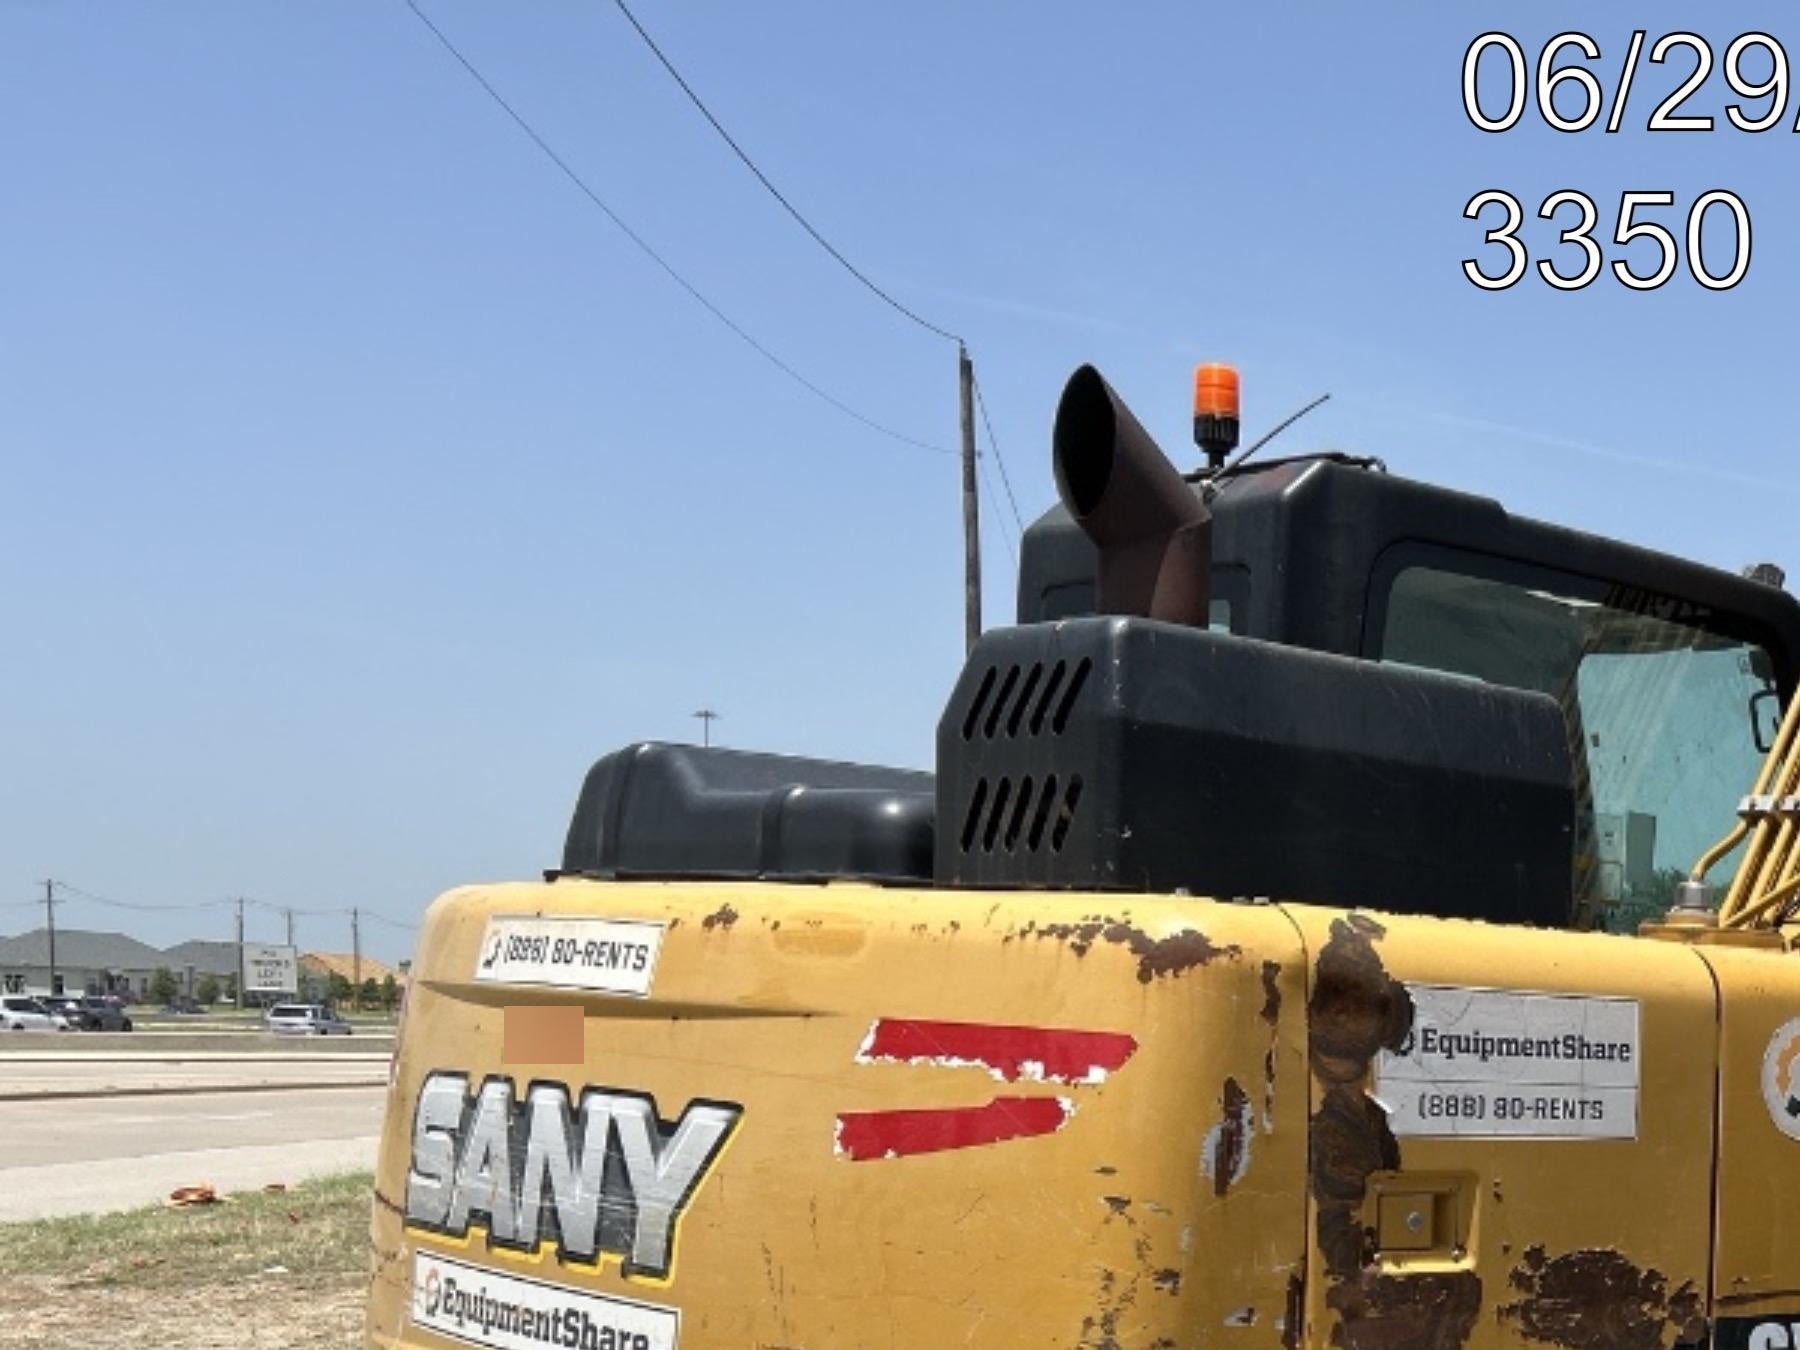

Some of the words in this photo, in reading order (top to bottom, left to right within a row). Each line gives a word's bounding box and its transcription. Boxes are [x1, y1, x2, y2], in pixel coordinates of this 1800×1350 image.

[1420, 1027, 1631, 1062] EquipmentShare
[1418, 1092, 1486, 1120] (888)
[1493, 1097, 1604, 1120] 80-RENTS
[405, 1070, 746, 1280] SANY
